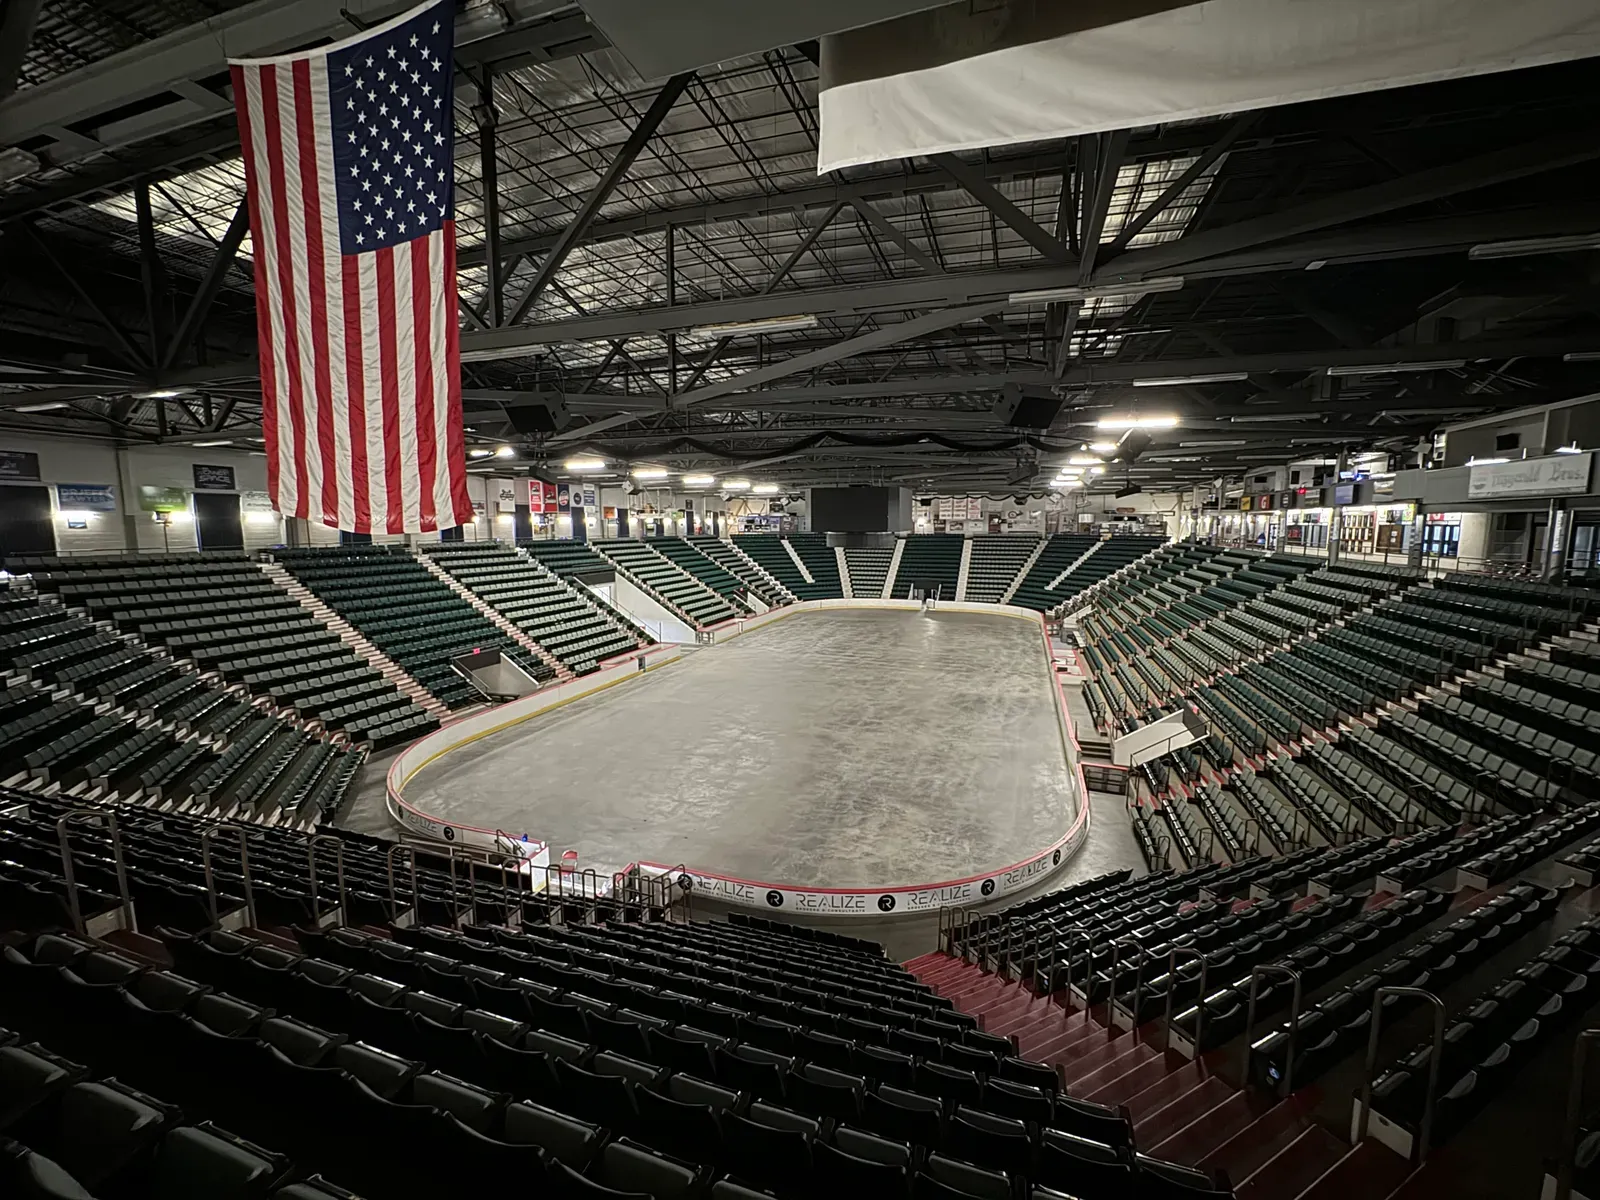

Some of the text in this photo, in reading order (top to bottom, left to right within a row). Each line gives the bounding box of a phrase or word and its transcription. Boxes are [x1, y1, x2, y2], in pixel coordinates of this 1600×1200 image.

[1548, 462, 1585, 482] Bros.
[1004, 857, 1048, 886] REALIZE
[796, 894, 865, 908] REALIZE
[908, 884, 971, 906] REALIZE
